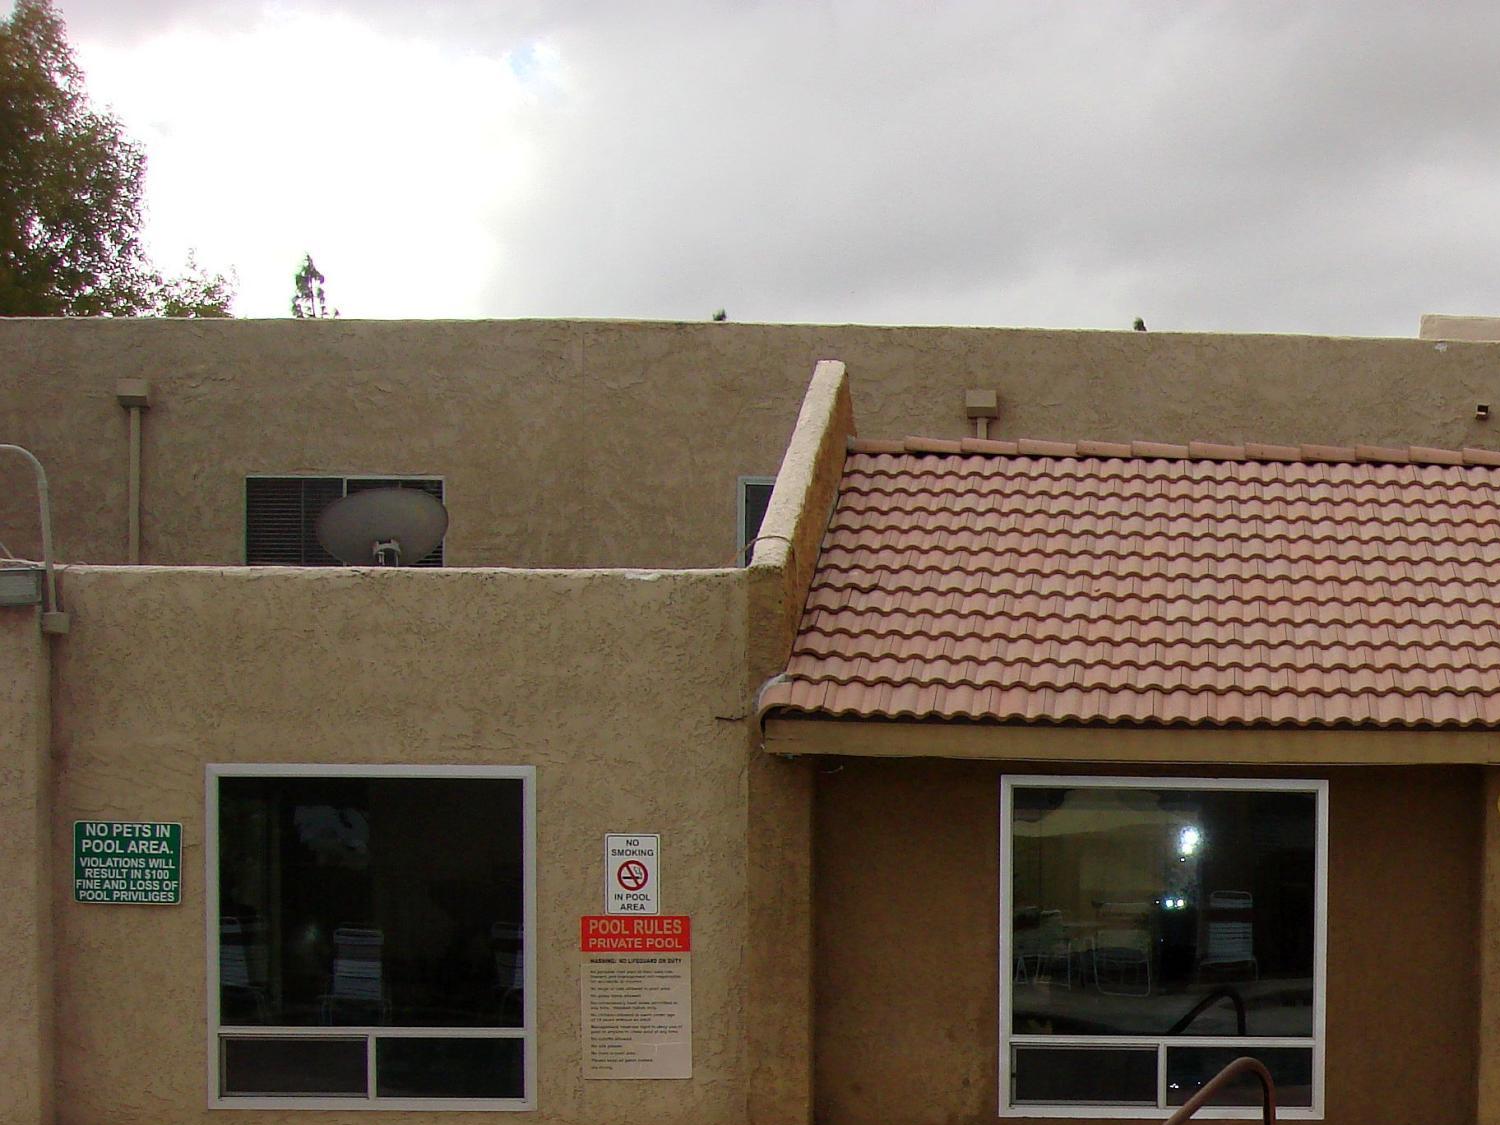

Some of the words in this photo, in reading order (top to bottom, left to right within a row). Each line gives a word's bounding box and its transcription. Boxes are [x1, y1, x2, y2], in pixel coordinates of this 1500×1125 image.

[86, 824, 108, 836] NO
[113, 825, 152, 837] PETS
[156, 825, 170, 838] IN
[82, 840, 125, 853] POOL
[128, 841, 174, 854] AREA.
[80, 857, 145, 868] VIOLATIONS
[149, 858, 176, 868] WILL
[85, 869, 128, 879] RESULT
[131, 869, 141, 879] IN
[144, 870, 169, 879] $100
[76, 880, 101, 889] FINE
[103, 880, 127, 890] AND
[130, 881, 160, 890] LOSS
[163, 881, 178, 890] OF
[79, 891, 110, 900] POOL
[113, 891, 174, 901] PRIVILIGES
[589, 920, 629, 934] POOL
[634, 920, 682, 934] RULES
[589, 938, 642, 948] PRIVATE
[646, 938, 682, 948] POOL
